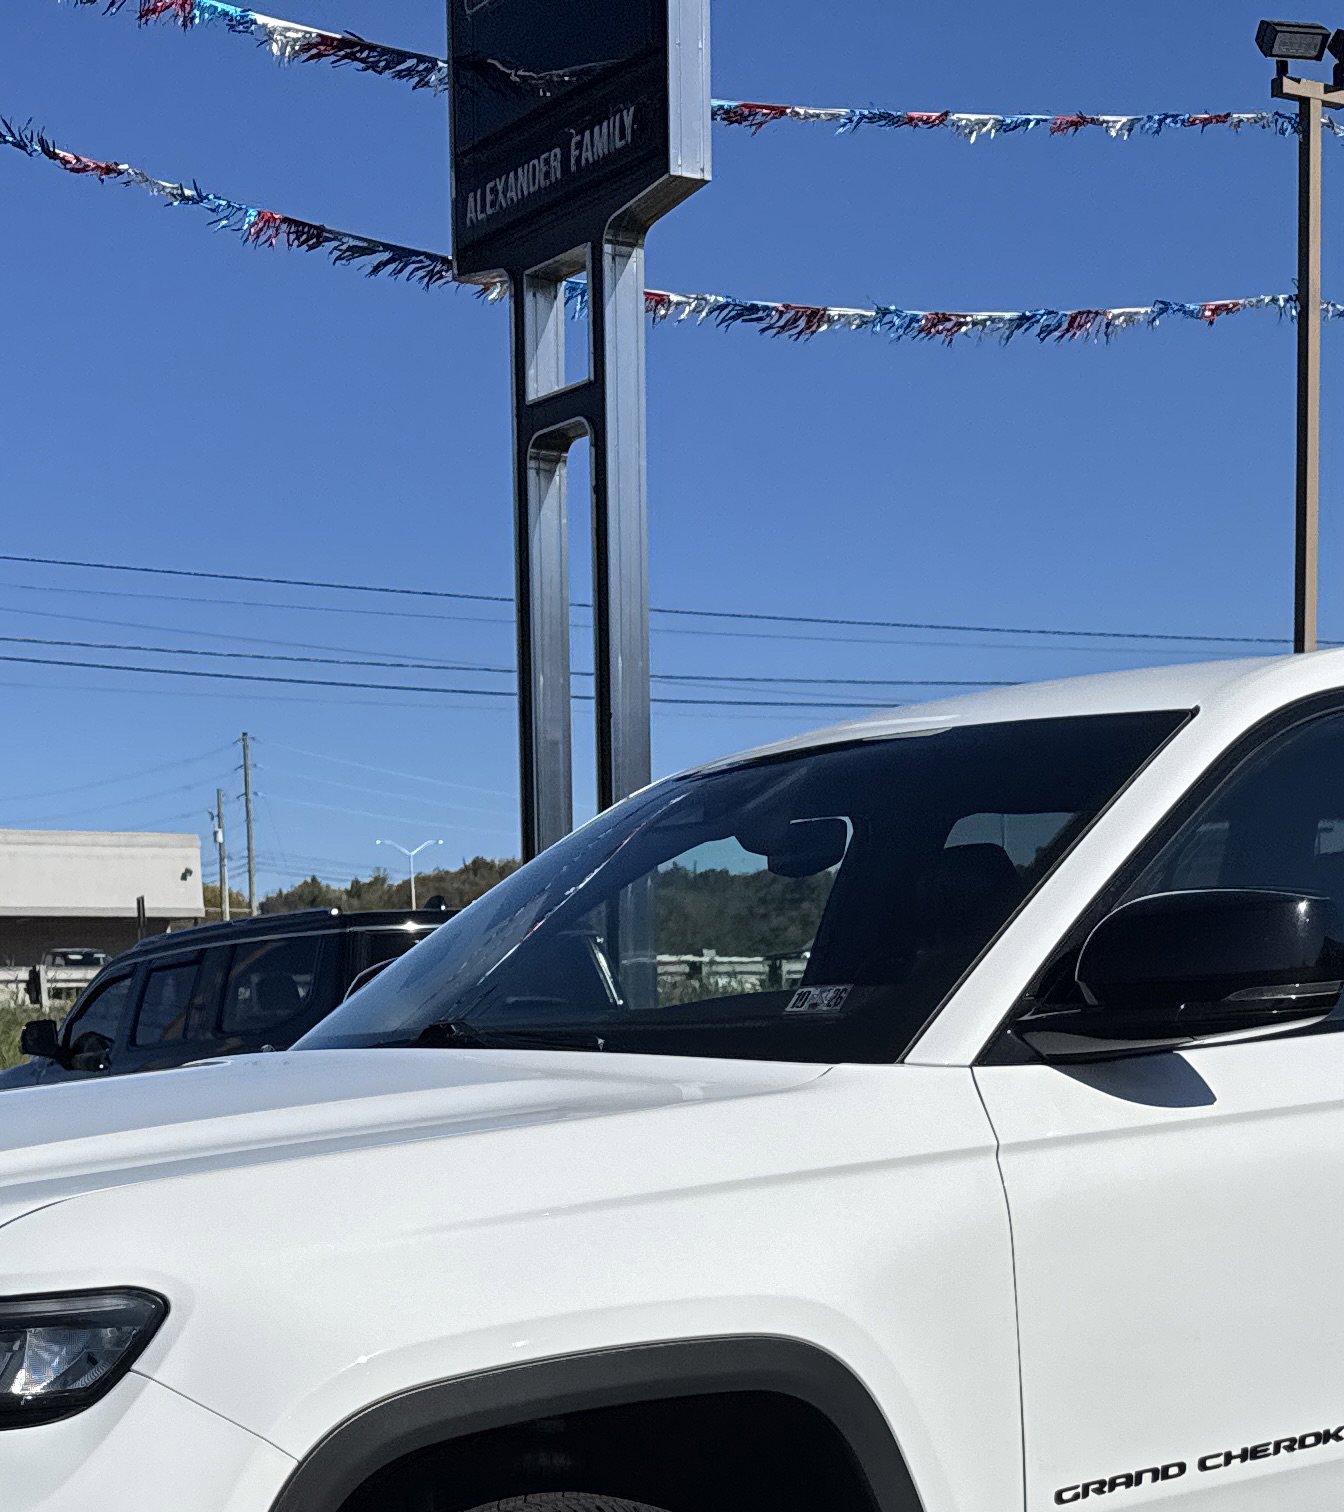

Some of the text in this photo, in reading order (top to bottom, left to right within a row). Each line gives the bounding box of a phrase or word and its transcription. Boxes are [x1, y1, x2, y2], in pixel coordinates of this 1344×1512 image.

[465, 106, 635, 228] ALEXANDER FAMILY
[1053, 1460, 1187, 1505] GRAND
